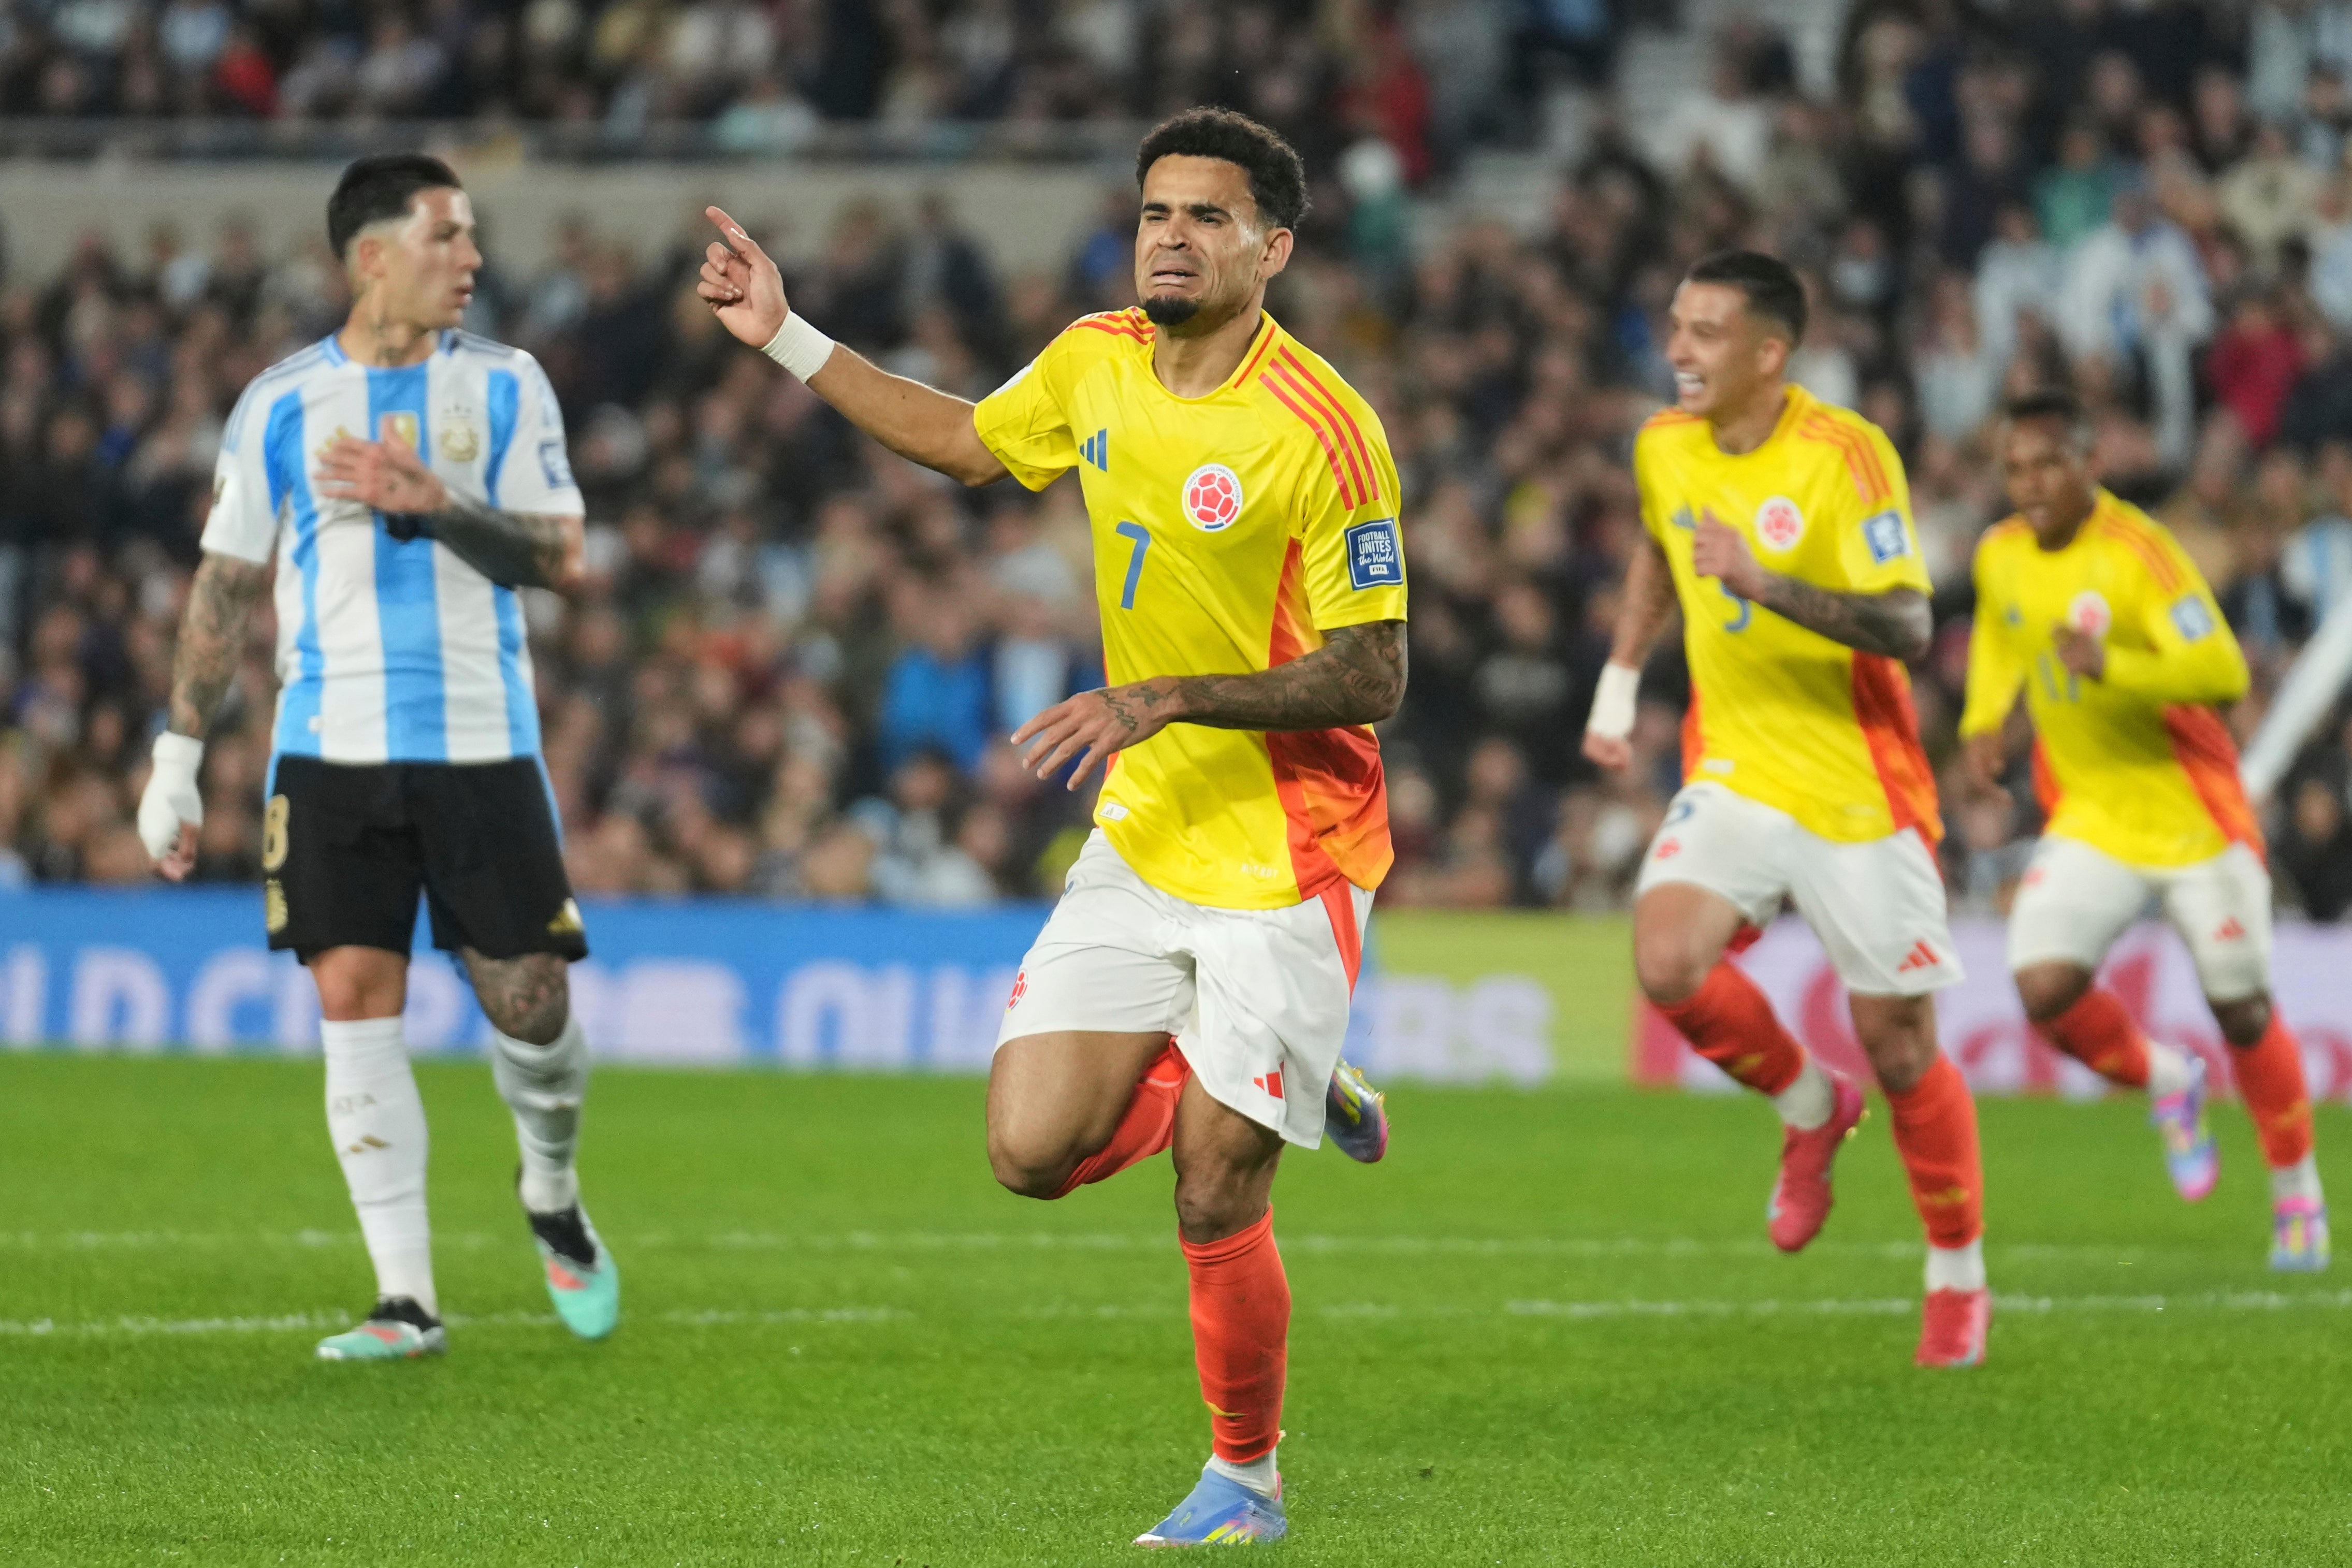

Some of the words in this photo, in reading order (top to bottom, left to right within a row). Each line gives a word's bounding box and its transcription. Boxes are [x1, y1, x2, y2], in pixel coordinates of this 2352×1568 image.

[1357, 530, 1390, 544] FOOTBALL
[1358, 540, 1391, 555] UNITES
[1115, 521, 1151, 610] 7
[1357, 554, 1372, 566] the
[1372, 551, 1394, 563] World
